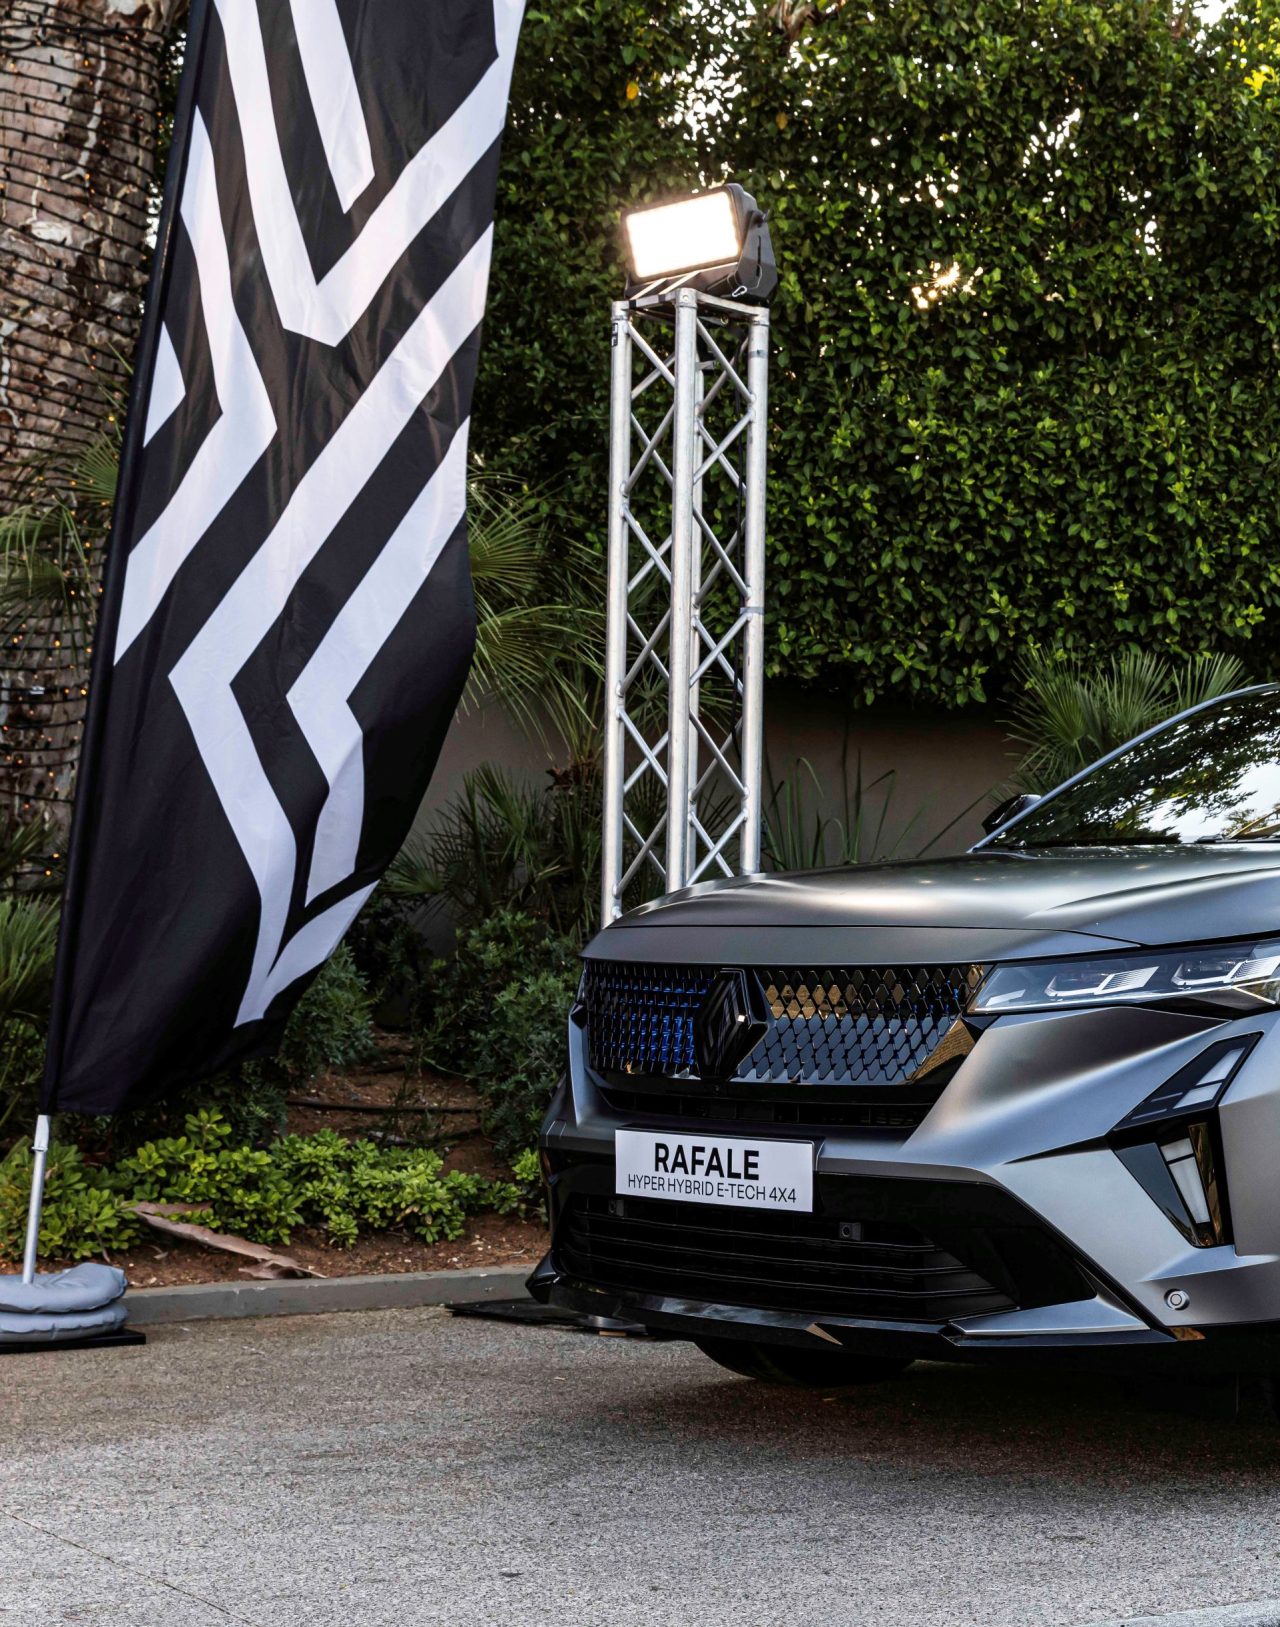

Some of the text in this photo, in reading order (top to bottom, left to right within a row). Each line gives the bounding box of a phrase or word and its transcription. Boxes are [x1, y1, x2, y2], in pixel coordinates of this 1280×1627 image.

[655, 1143, 759, 1180] RAFALE
[628, 1174, 797, 1203] HYPER HYBRID E-TECH 4X4
